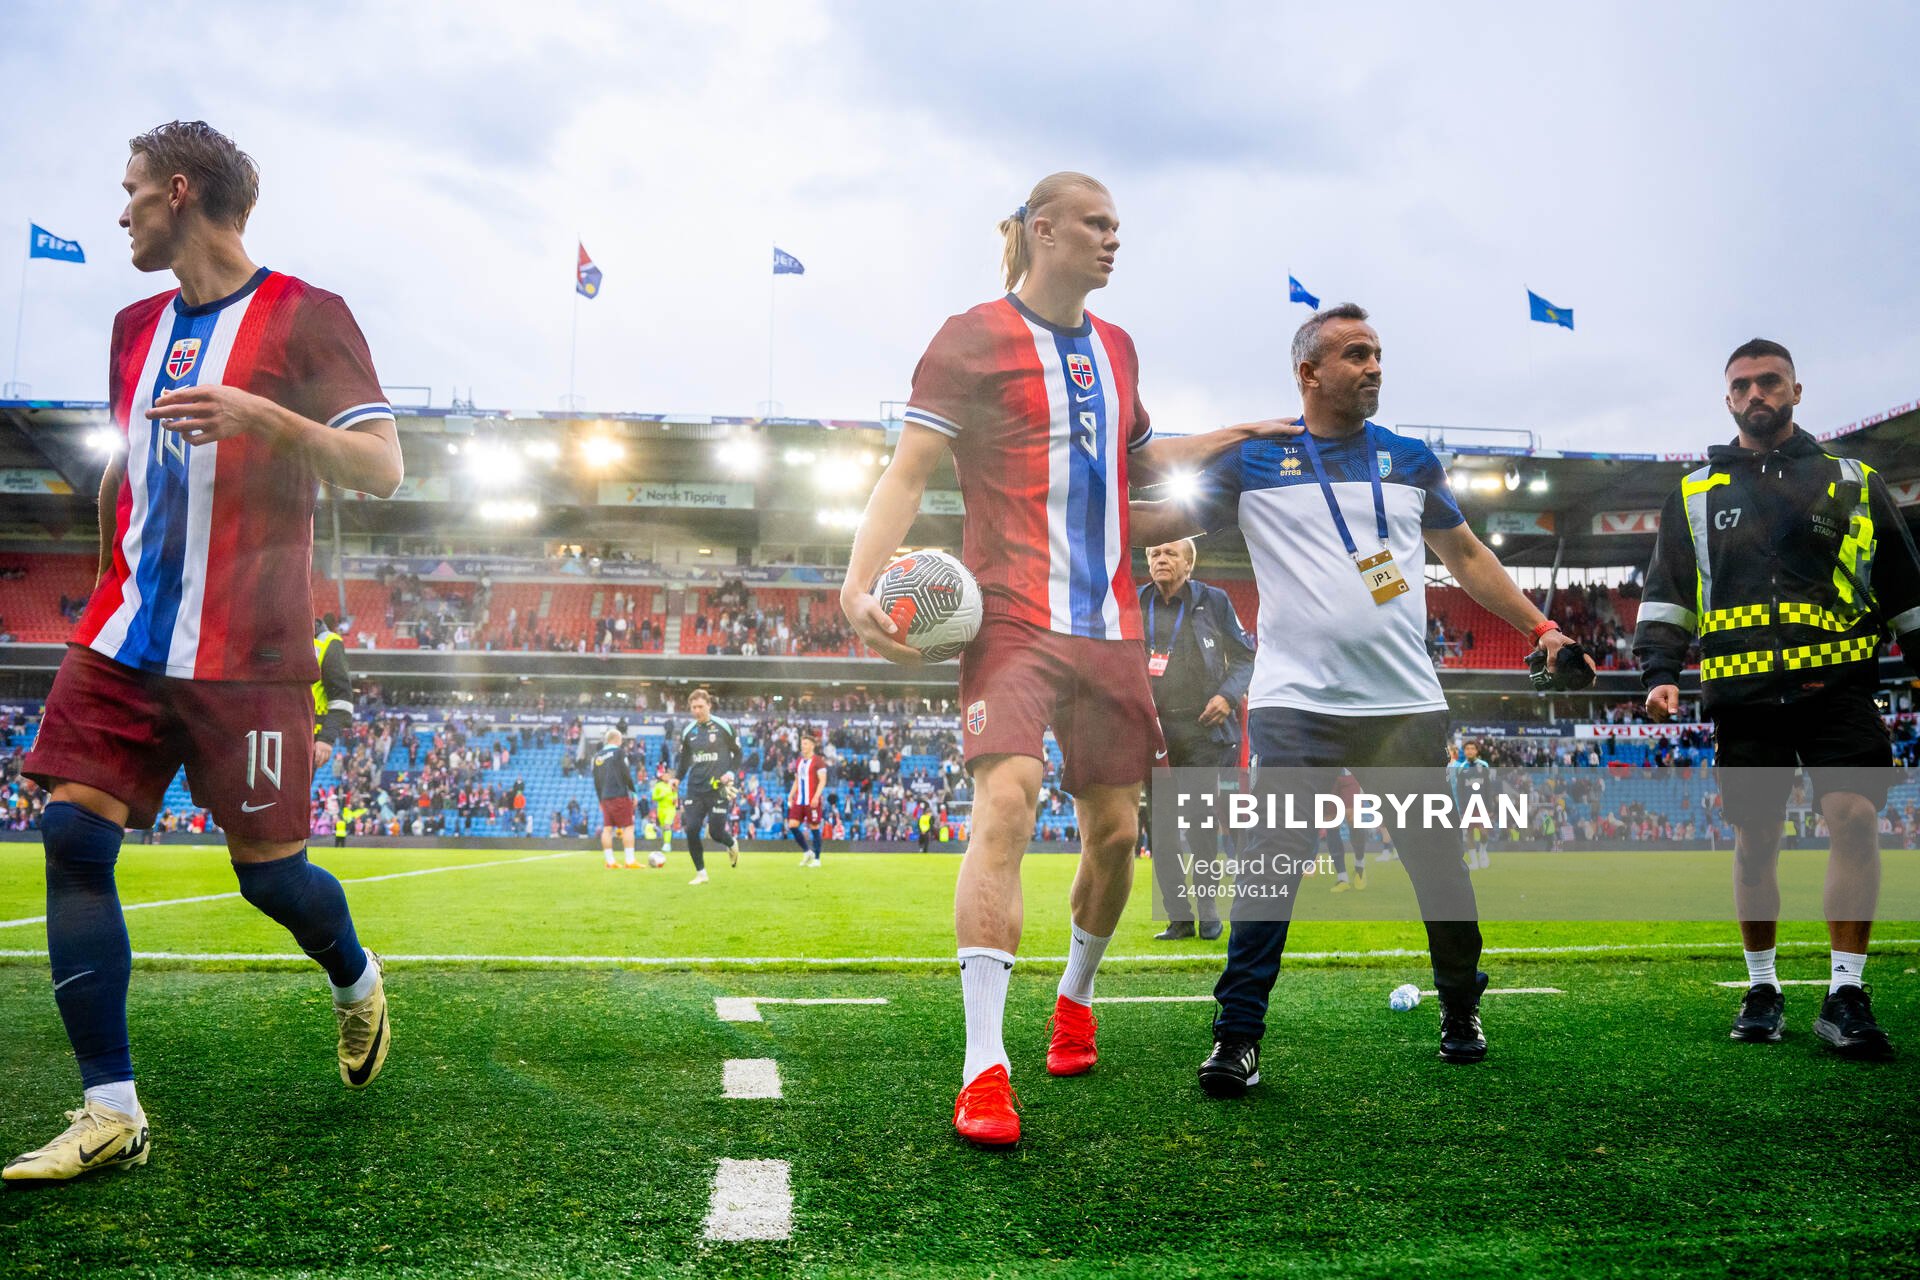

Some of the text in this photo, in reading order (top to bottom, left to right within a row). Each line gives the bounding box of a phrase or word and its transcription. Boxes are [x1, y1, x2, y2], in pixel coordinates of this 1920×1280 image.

[1079, 411, 1098, 461] 9
[646, 490, 727, 505] Norsk Tipping
[1714, 507, 1742, 531] C-7
[244, 730, 282, 791] 10
